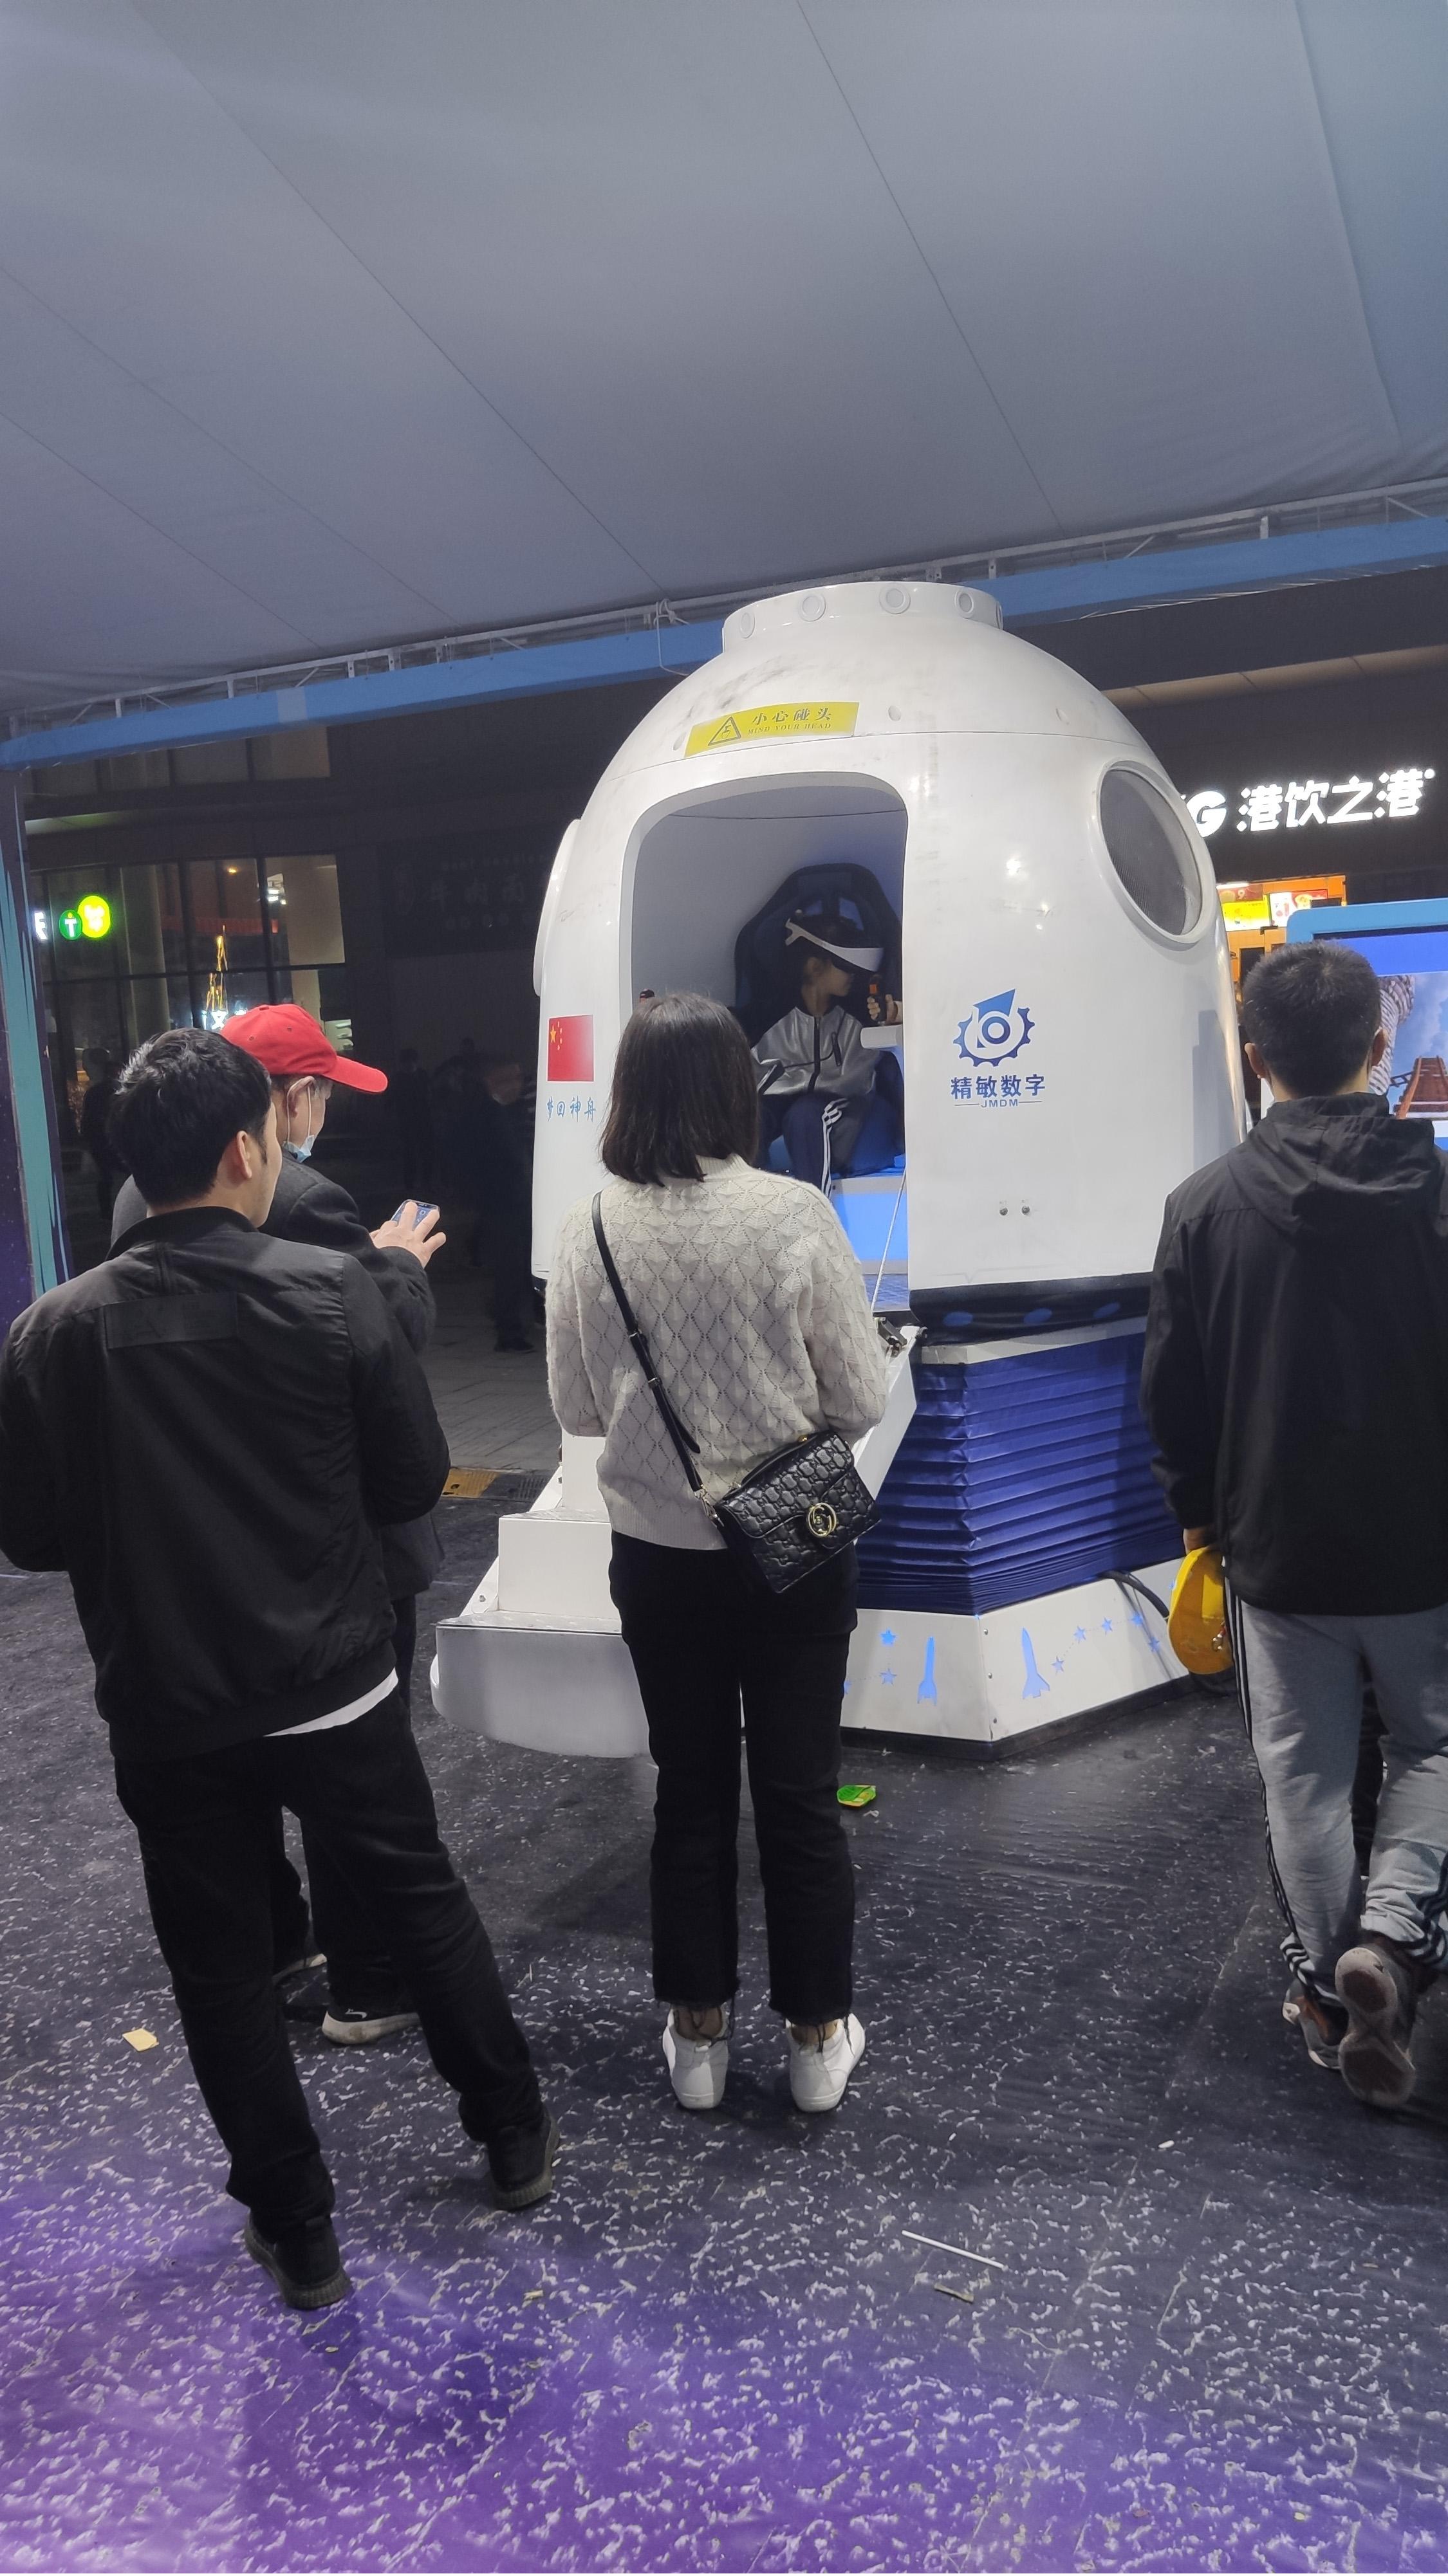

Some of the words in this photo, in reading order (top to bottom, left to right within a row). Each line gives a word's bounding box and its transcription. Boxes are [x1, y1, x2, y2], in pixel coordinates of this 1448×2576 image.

[752, 708, 831, 725] 小心碰头
[747, 726, 770, 735] MIND
[1236, 768, 1424, 832] 港饮之港
[951, 1074, 1046, 1099] 精敏数字
[547, 1096, 597, 1123] 梦回神舟
[980, 1099, 1018, 1108] JMDM
